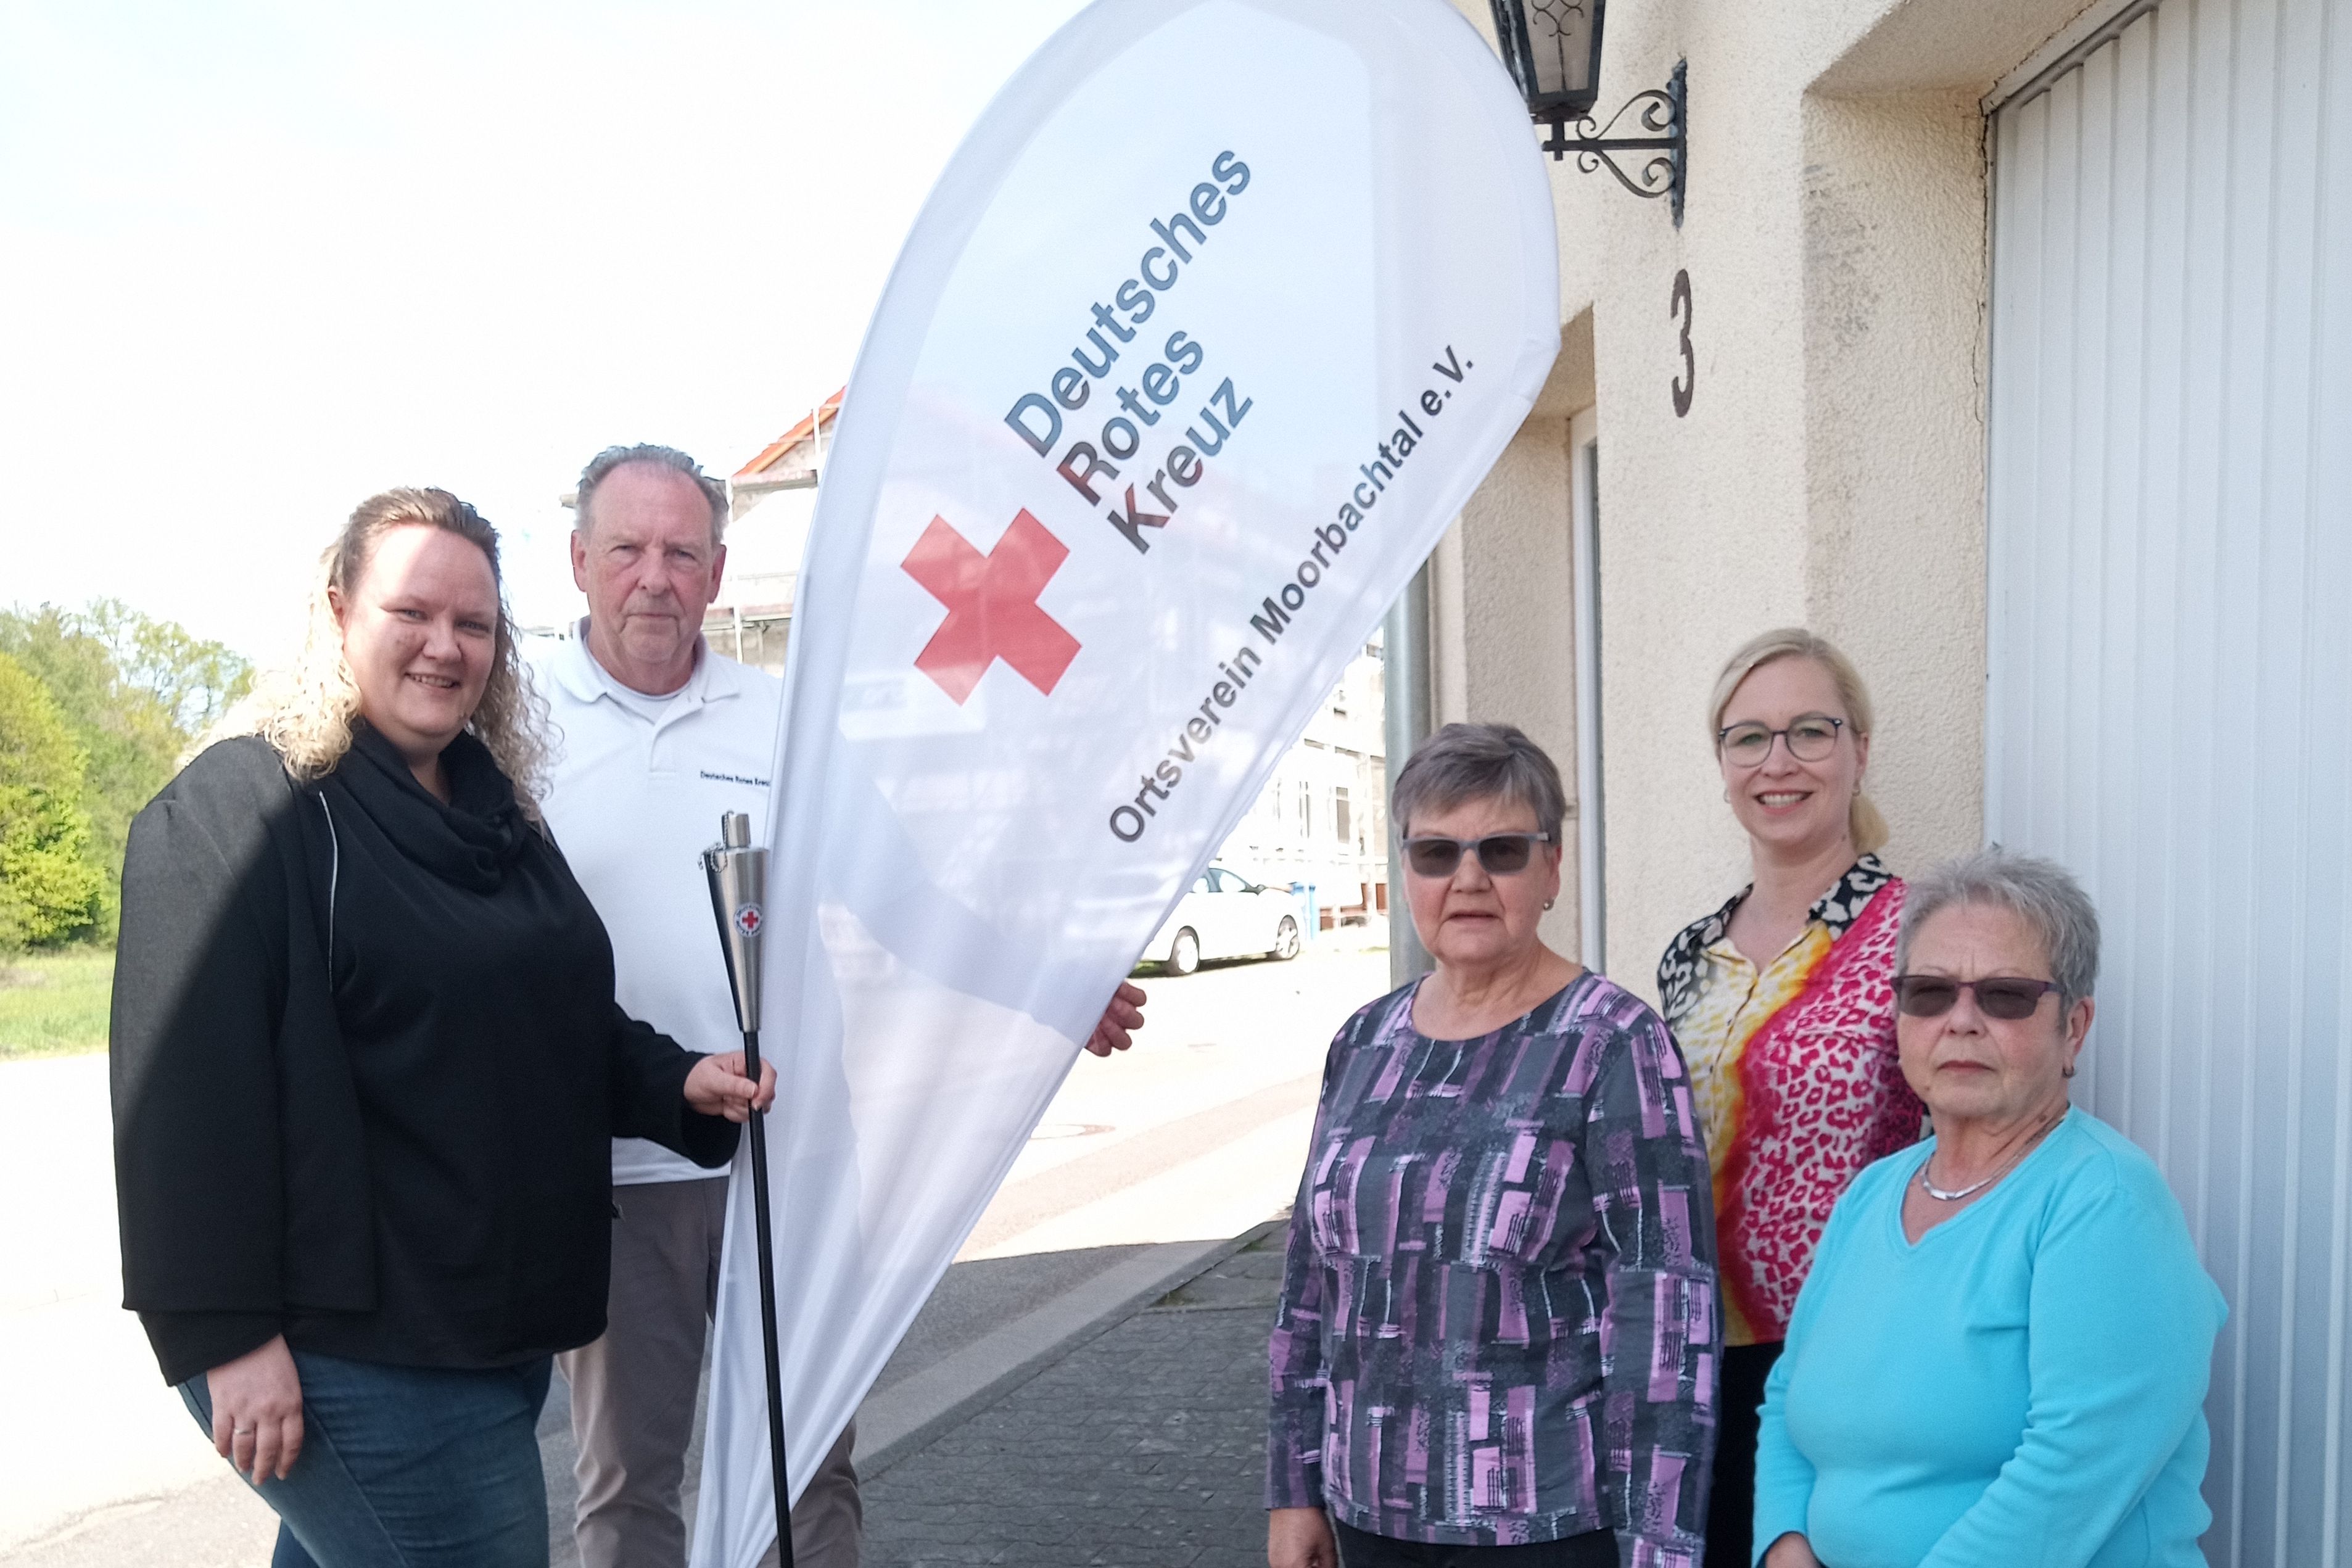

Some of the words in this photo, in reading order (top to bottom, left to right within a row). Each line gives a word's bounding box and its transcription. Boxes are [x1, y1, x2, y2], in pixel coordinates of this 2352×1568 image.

[1003, 149, 1251, 460] Deutsches
[1670, 268, 1696, 419] 3
[1055, 330, 1204, 508] Rotes
[1106, 376, 1254, 556] Kreuz
[1108, 646, 1262, 843] Ortsverein
[1249, 409, 1425, 646] Moorbachtal
